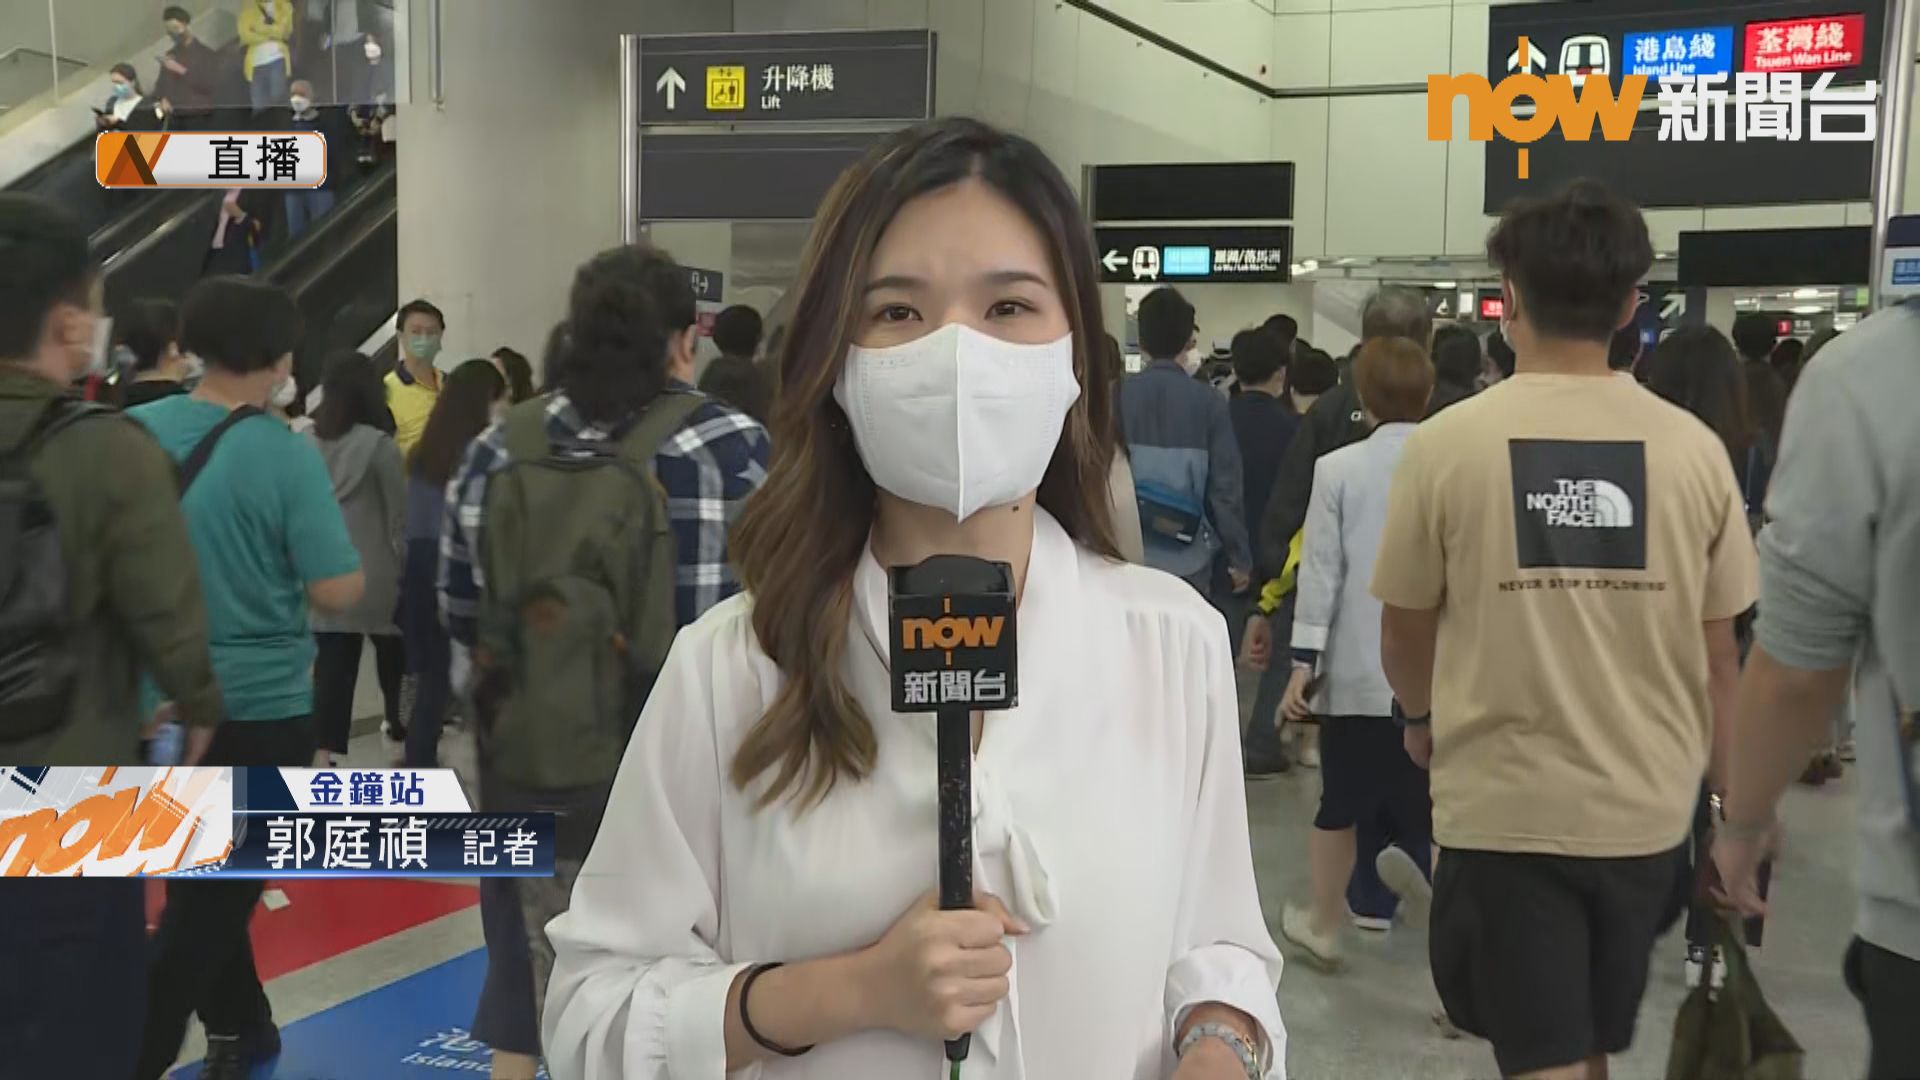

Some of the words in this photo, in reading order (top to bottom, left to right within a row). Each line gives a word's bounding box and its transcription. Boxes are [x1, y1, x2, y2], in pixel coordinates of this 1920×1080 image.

[1634, 33, 1716, 63] 港島綫
[1754, 54, 1791, 69] Tsuen
[1793, 52, 1822, 65] Wan
[1823, 50, 1852, 63] Line
[761, 64, 834, 92] 升降機
[1633, 63, 1668, 76] Island
[1670, 62, 1696, 75] Line
[761, 95, 781, 110] Lift
[1555, 479, 1595, 496] THE
[1526, 493, 1594, 511] NORTH
[1546, 510, 1595, 527] FACE
[1498, 578, 1543, 592] NEVER
[1549, 577, 1581, 590] STOP
[902, 614, 1005, 650] now
[904, 668, 1006, 703] 新聞台
